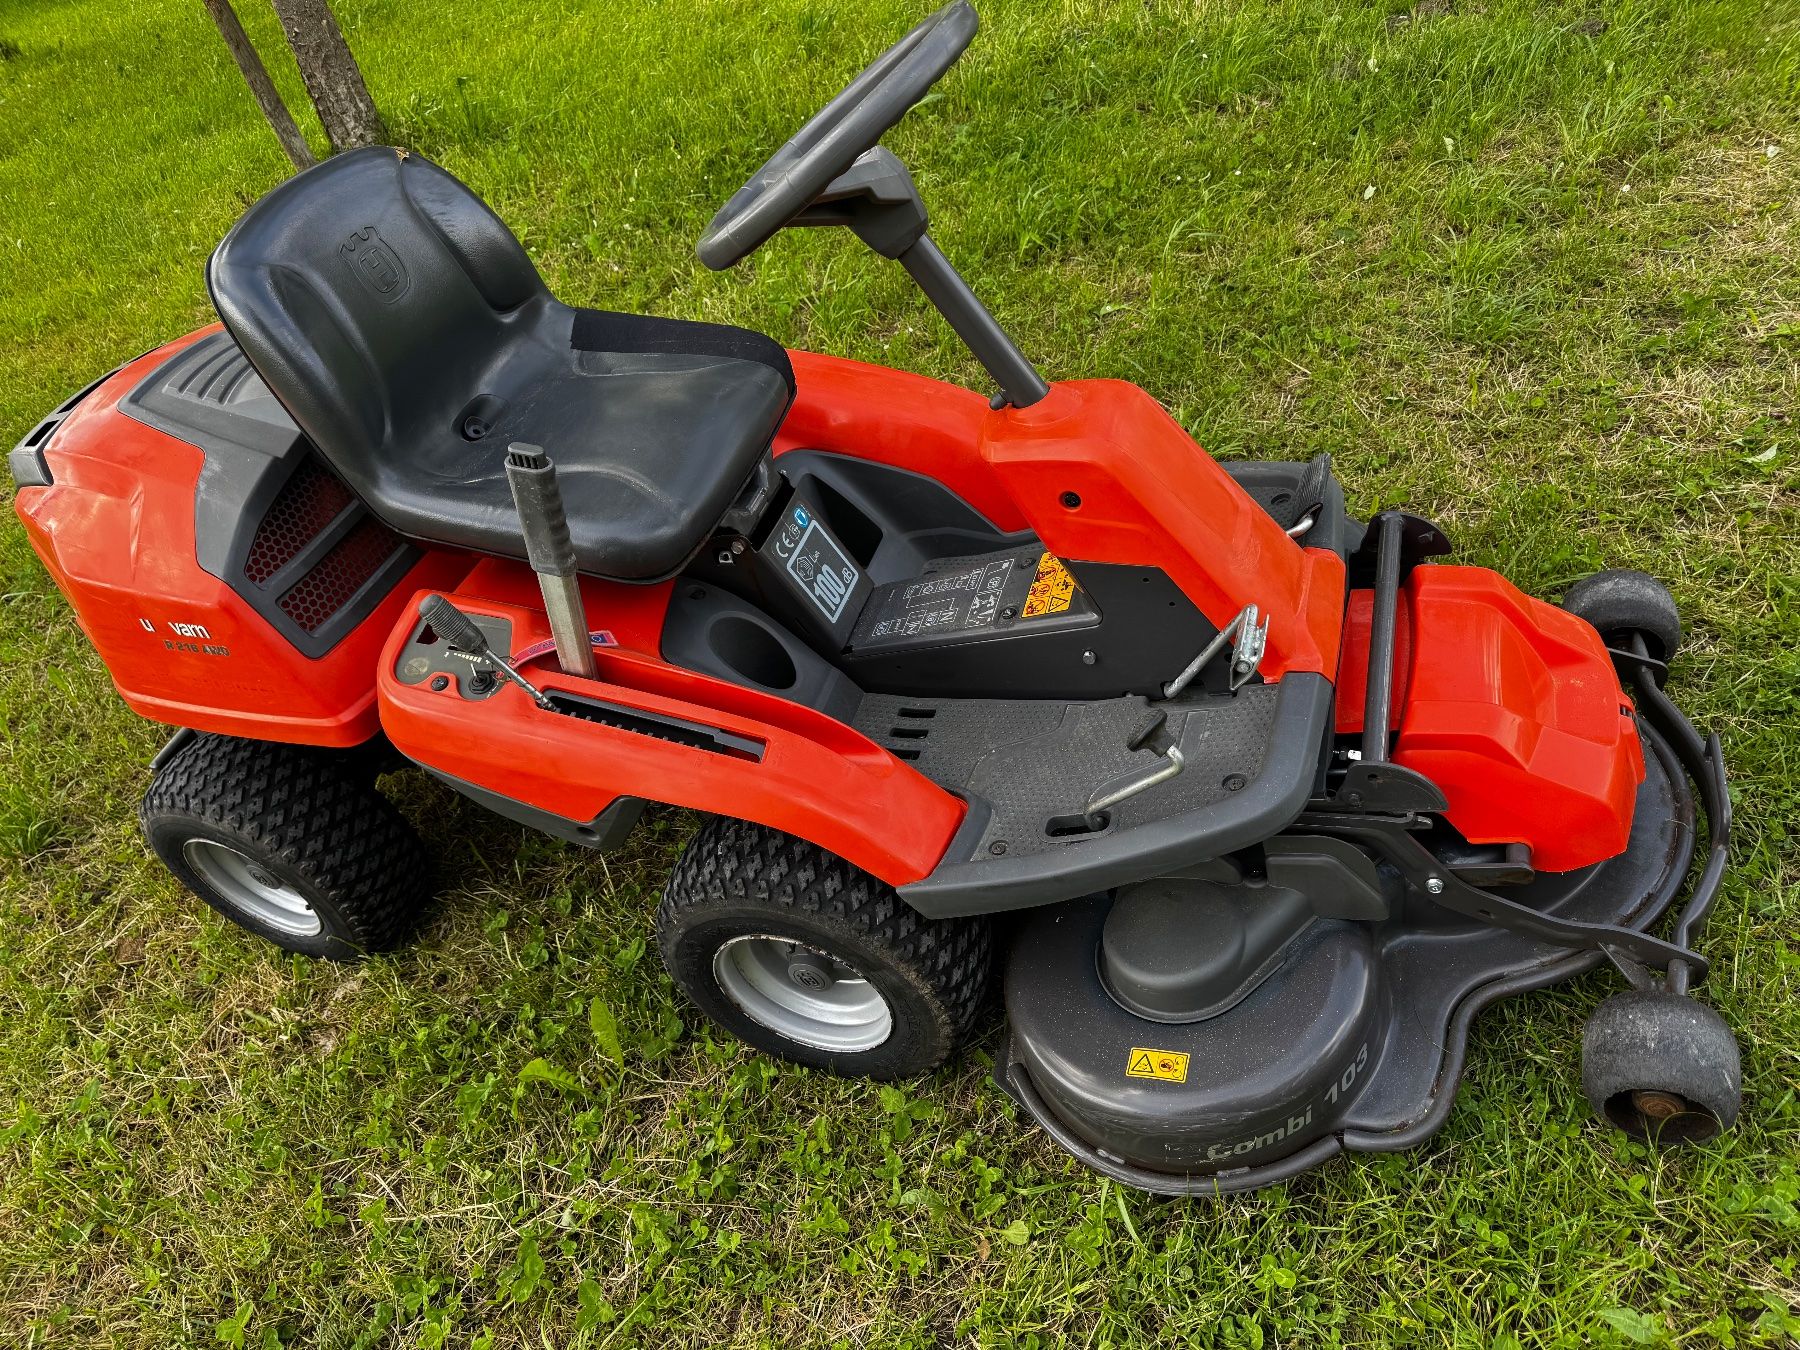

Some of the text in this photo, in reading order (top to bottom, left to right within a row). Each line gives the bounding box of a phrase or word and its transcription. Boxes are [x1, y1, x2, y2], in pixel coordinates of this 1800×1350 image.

[814, 564, 852, 610] 100 dB
[176, 642, 199, 652] 216
[1207, 1042, 1368, 1160] Combi 103
